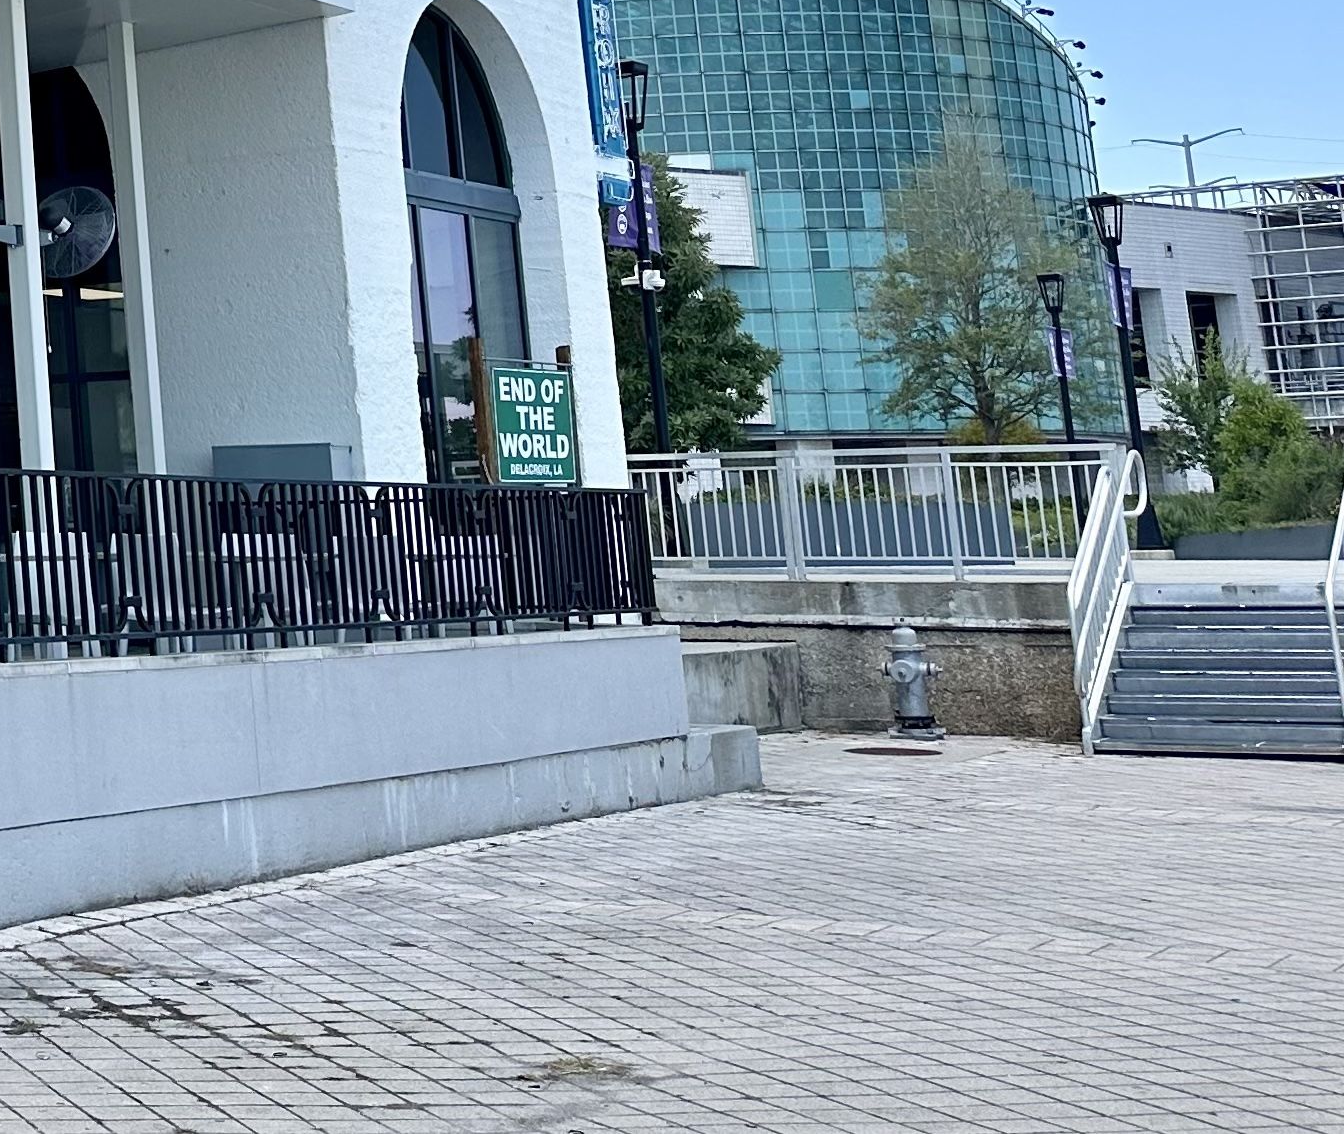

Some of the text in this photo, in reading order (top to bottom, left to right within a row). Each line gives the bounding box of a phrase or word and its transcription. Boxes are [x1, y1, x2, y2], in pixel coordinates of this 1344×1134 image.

[498, 376, 564, 404] END OF
[515, 405, 556, 431] THE
[499, 432, 570, 459] WORLD
[510, 463, 564, 477] DELACROIX, LA
